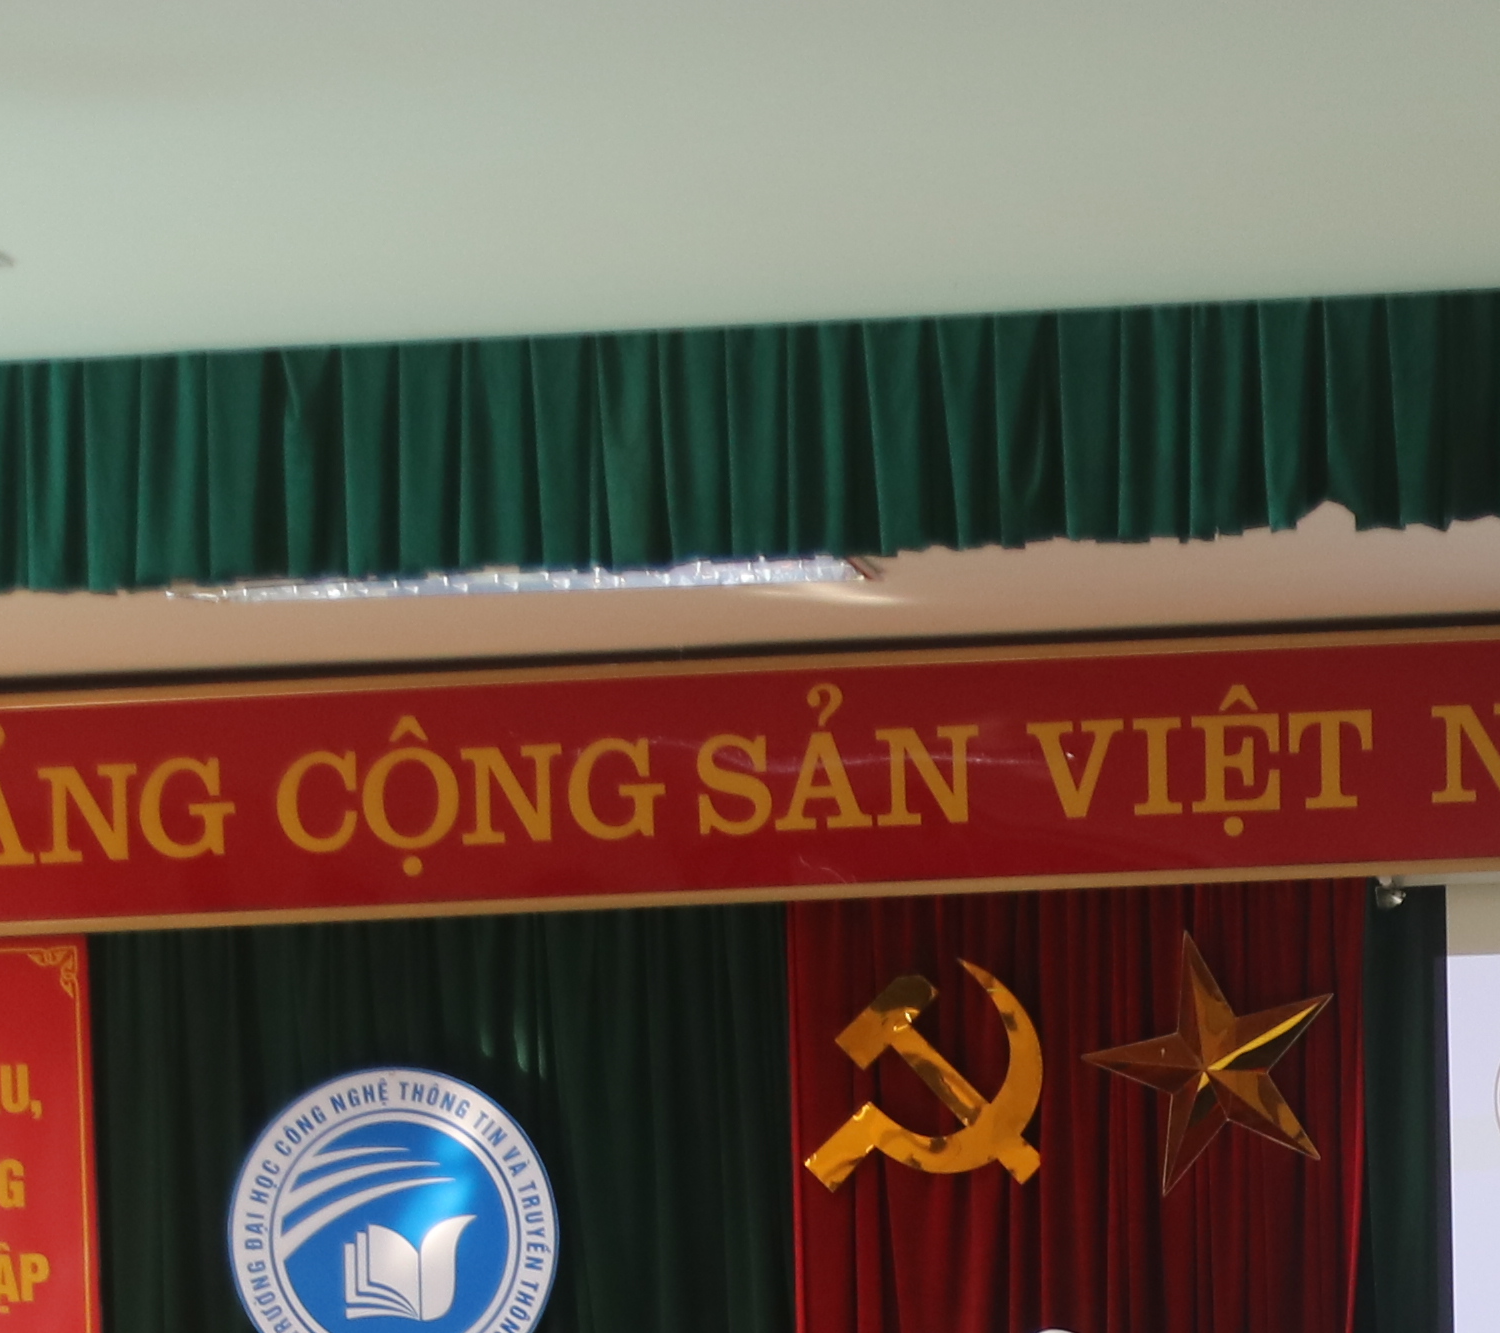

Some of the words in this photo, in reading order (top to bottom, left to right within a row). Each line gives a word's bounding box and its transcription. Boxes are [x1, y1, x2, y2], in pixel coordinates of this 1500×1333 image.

[276, 715, 665, 876] CỘNG
[696, 684, 974, 838] SẢN
[1027, 685, 1372, 837] VIỆT
[329, 1077, 388, 1114] NGHỆ
[398, 1081, 471, 1119] THÔNG
[273, 1104, 328, 1157] CÔNG
[473, 1110, 508, 1148] TIN
[502, 1145, 531, 1178] VÀ
[249, 1159, 280, 1204] HỌC
[244, 1212, 268, 1251] ĐẠI
